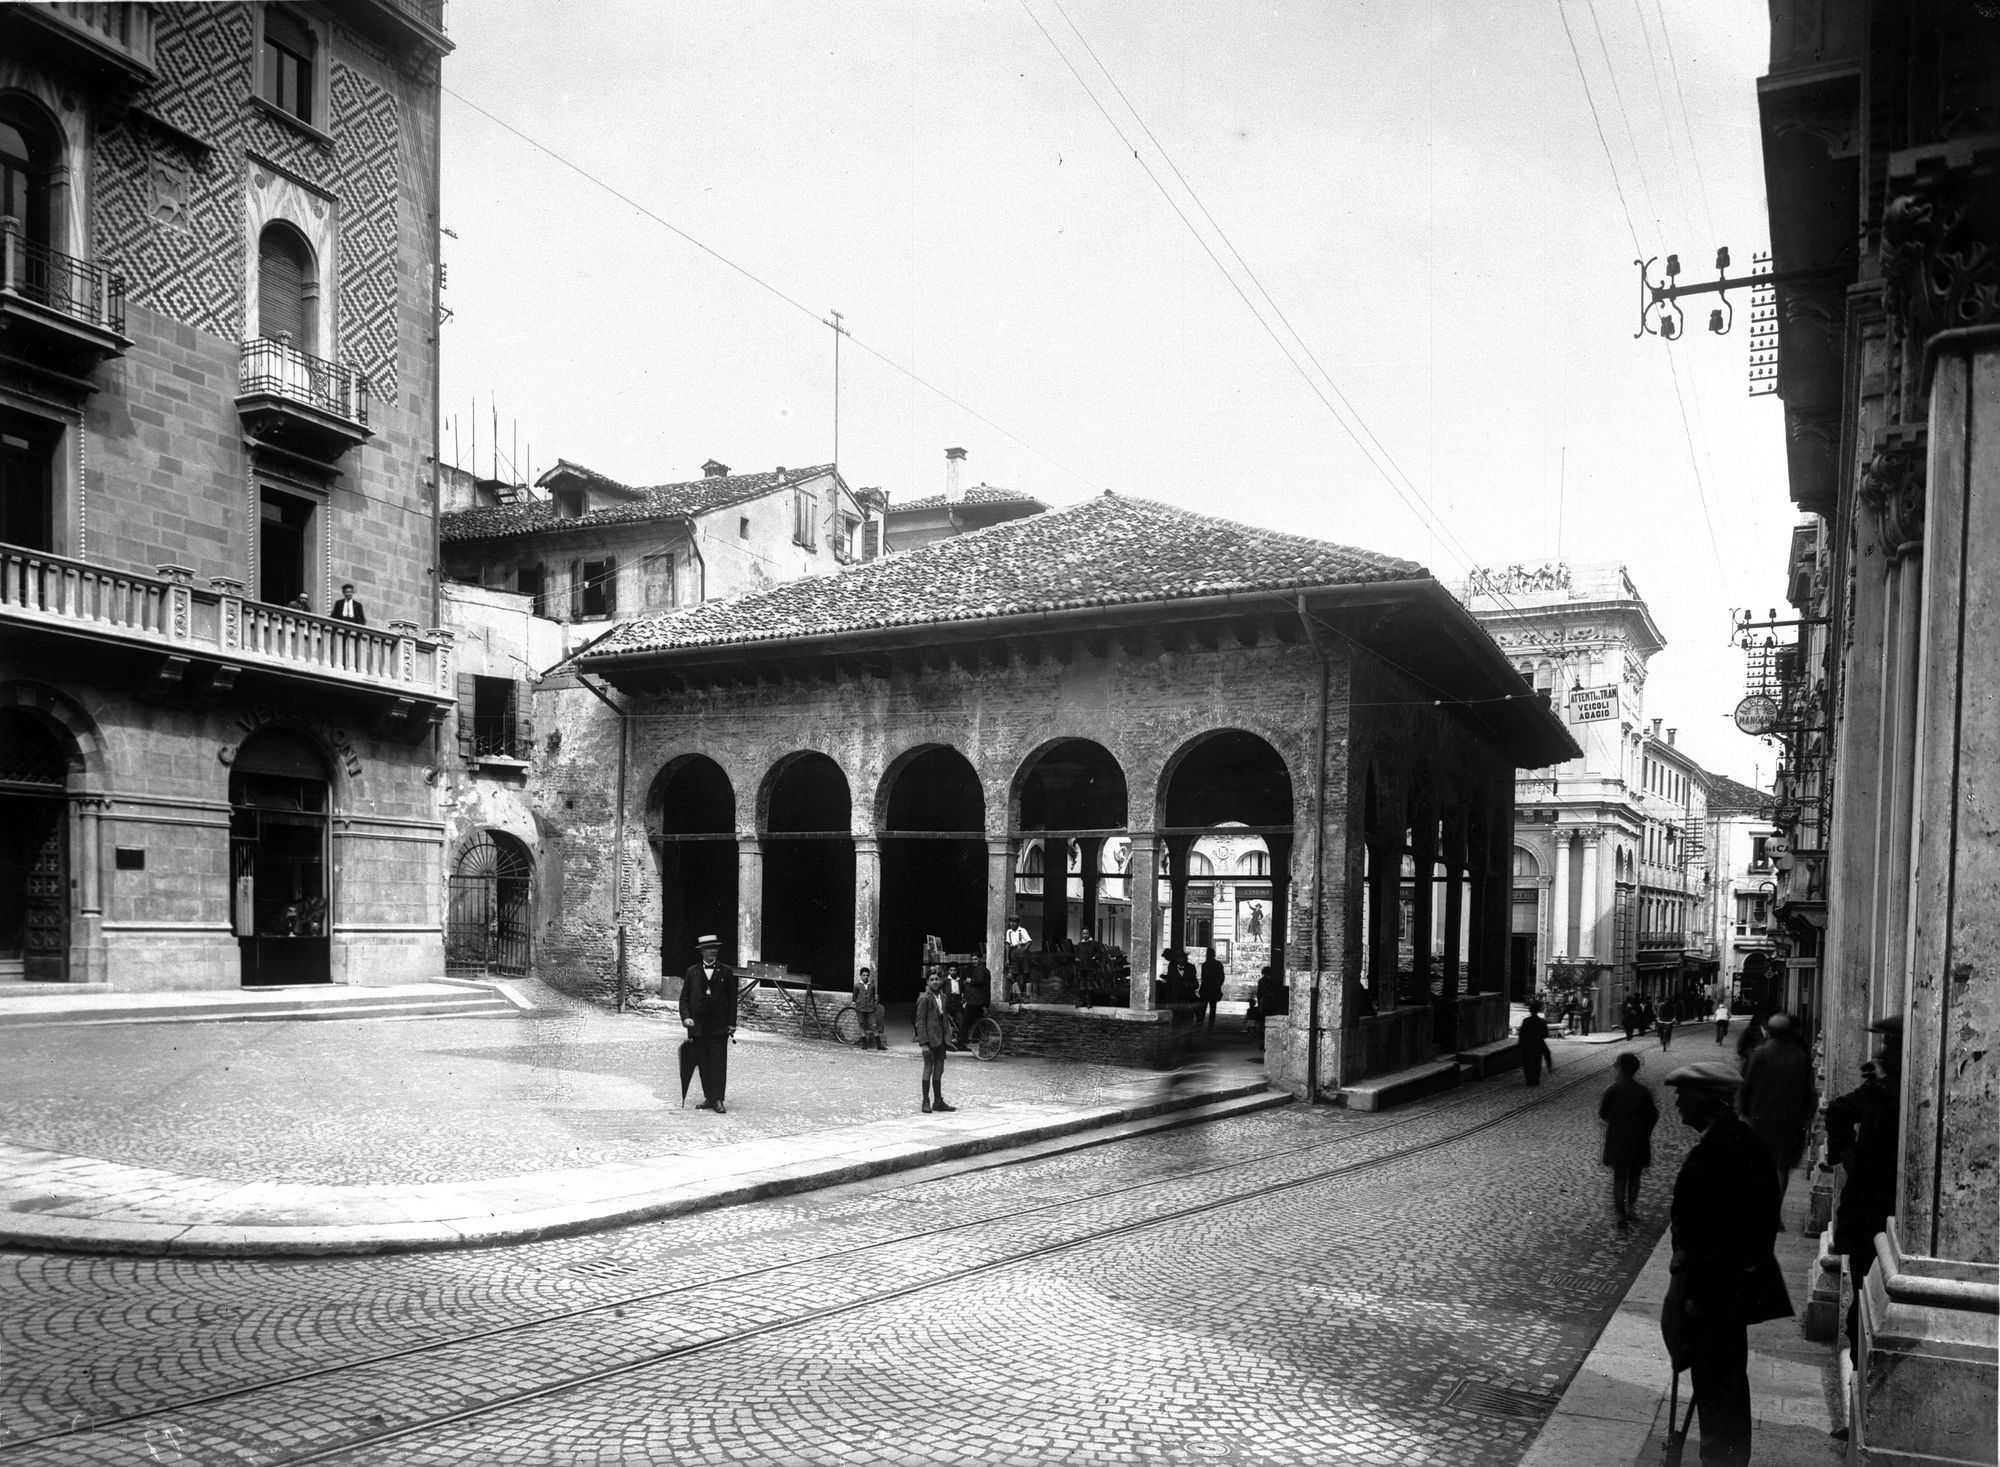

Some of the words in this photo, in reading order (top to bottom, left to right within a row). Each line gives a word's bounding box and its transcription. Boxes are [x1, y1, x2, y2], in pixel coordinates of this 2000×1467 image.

[1571, 691, 1596, 703] ATTENTI
[1600, 688, 1617, 699] TRAM
[1578, 702, 1609, 711] VEICOLI
[1740, 698, 1775, 716] ALBERGO
[1579, 709, 1610, 720] ADAGIO
